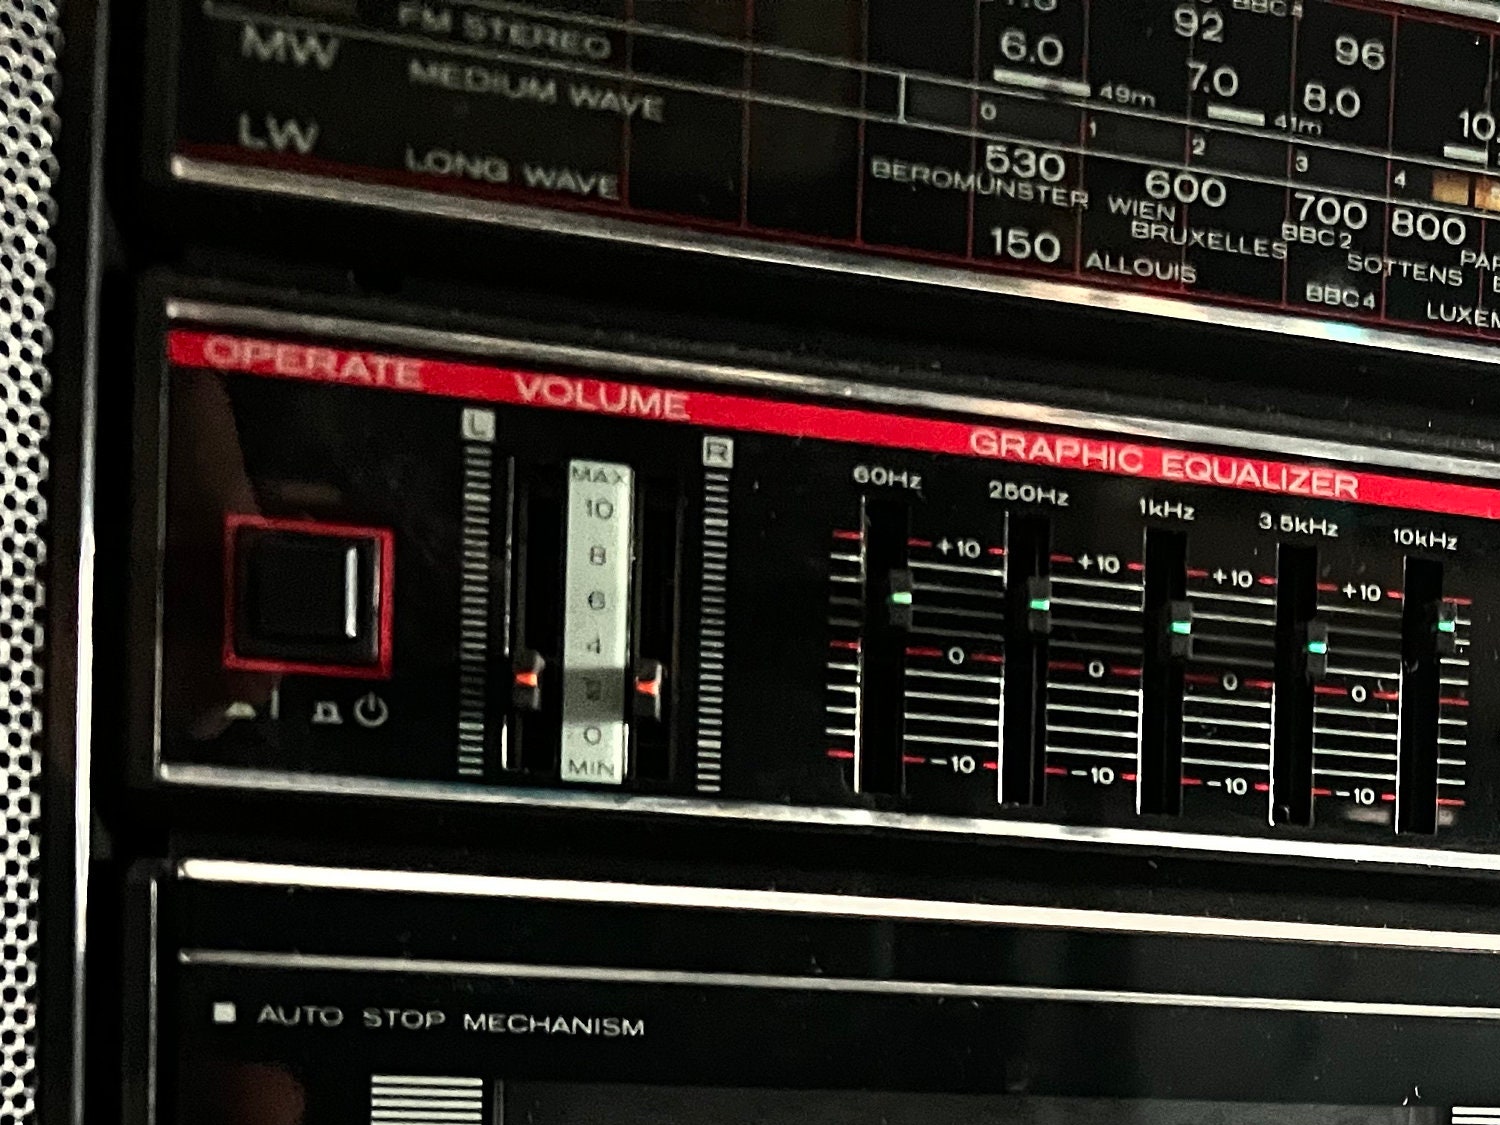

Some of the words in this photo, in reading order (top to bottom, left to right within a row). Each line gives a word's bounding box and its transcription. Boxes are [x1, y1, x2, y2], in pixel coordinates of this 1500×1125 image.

[462, 13, 612, 60] STEREO
[1174, 7, 1224, 43] 92
[241, 24, 339, 70] MW
[1001, 28, 1064, 66] 6.0
[1335, 35, 1385, 71] 96
[409, 58, 557, 102] MEDIUM
[568, 83, 665, 124] WAVE
[1187, 59, 1239, 97] 7.0
[1100, 83, 1155, 107] 49m
[1304, 82, 1360, 118] 8.0
[981, 103, 996, 120] 0
[1274, 114, 1322, 136] 41m
[238, 111, 319, 154] LW
[1090, 121, 1097, 138] 1
[1192, 138, 1206, 156] 2
[406, 144, 509, 184] LONG
[522, 160, 619, 200] WAVE
[985, 145, 1066, 183] 530
[1295, 155, 1308, 172] 3
[1145, 170, 1226, 208] 600
[1394, 170, 1406, 189] 4
[1108, 195, 1176, 222] WIEN
[1294, 192, 1368, 230] 700
[1132, 220, 1287, 260] BRUXELLES
[1392, 210, 1466, 245] 800
[990, 226, 1061, 263] 150
[1085, 251, 1197, 284] ALLOUIS
[1348, 254, 1463, 287] SOTTENS
[202, 333, 425, 389] OPERATE
[514, 372, 692, 420] VOLUME
[471, 411, 488, 435] L
[707, 443, 728, 462] R
[969, 428, 1144, 474] GRAPHIC
[1162, 452, 1360, 501] EQUALIZER
[572, 466, 626, 484] MAX
[853, 465, 922, 492] 60Hz
[990, 481, 1069, 508] 250Hz
[1140, 498, 1195, 522] 1kHz
[1258, 512, 1339, 539] 3.5kHz
[937, 539, 981, 558] +10
[1393, 528, 1459, 551] 10kHz
[1078, 555, 1120, 574] +10
[1213, 569, 1253, 589] +10
[1343, 583, 1381, 602] +10
[948, 646, 964, 666] 0
[1088, 659, 1105, 679] 0
[1222, 673, 1238, 692] 0
[1351, 685, 1367, 703] 0
[569, 760, 615, 776] MIN
[931, 755, 975, 773] -10
[1071, 766, 1114, 785] -10
[1207, 777, 1248, 796] -10
[1336, 788, 1375, 805] -10
[257, 1003, 344, 1028] AUTO
[363, 1007, 446, 1030] STOP
[463, 1012, 645, 1037] MECHANISM
